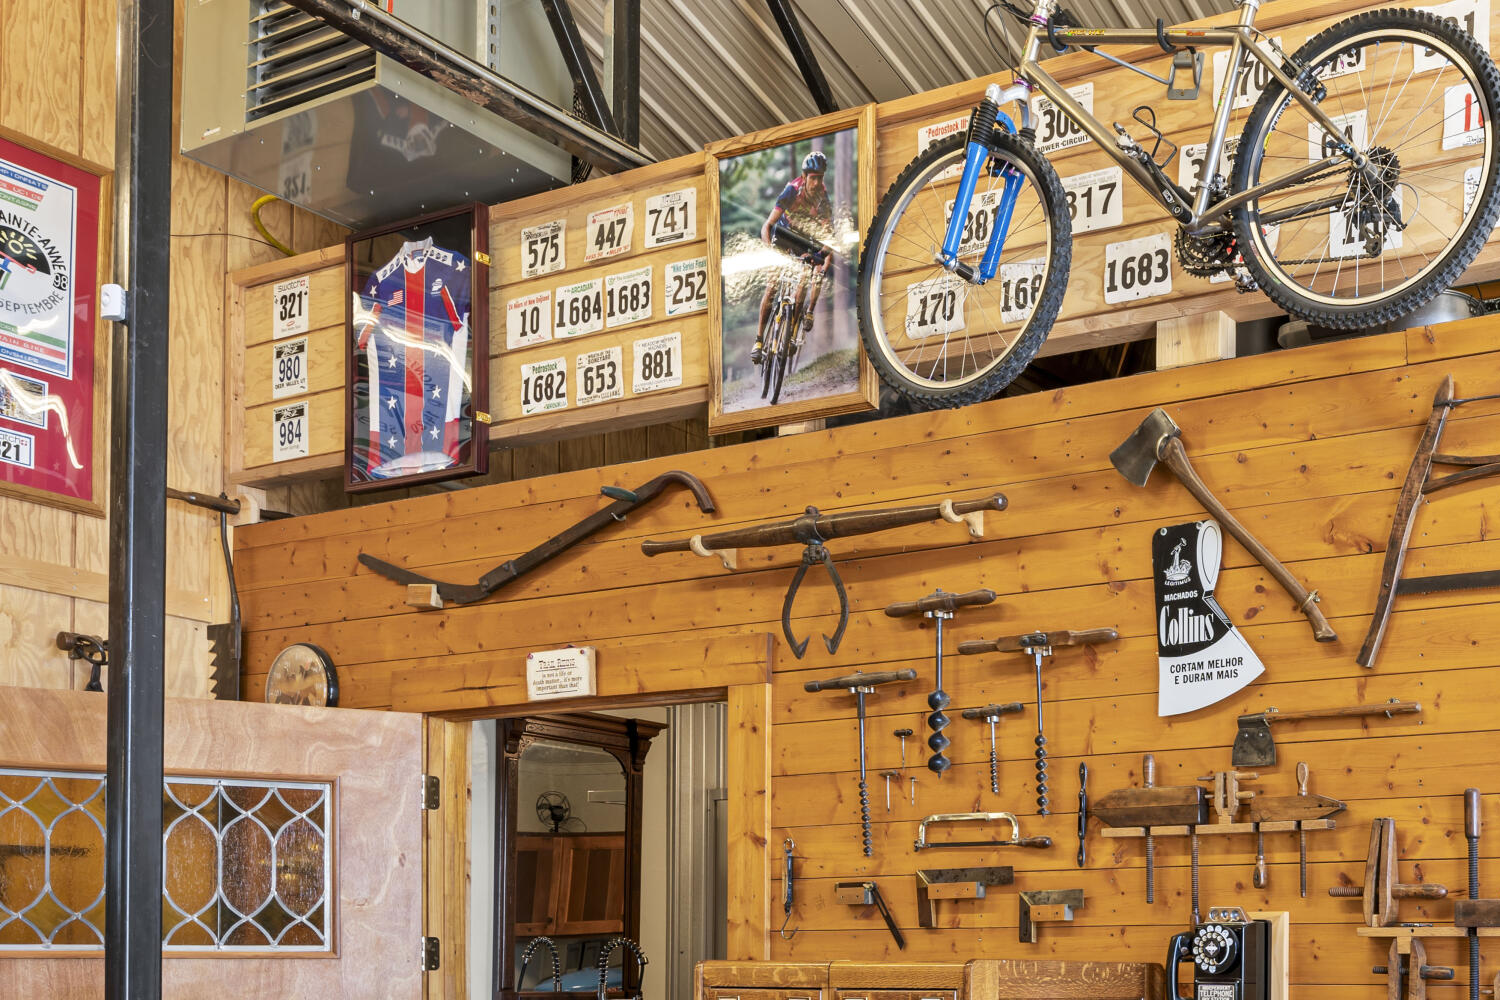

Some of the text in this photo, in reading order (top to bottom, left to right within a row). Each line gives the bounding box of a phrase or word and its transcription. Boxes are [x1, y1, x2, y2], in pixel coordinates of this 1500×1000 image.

[595, 218, 627, 251] 447
[649, 201, 688, 236] 741
[529, 234, 559, 269] 575
[672, 270, 707, 305] 252
[1106, 248, 1169, 294] 1683
[280, 291, 303, 321] 321
[556, 291, 602, 328] 1684
[607, 280, 650, 317] 1683
[918, 290, 956, 327] 170
[520, 306, 540, 337] 10
[279, 356, 300, 382] 980
[584, 361, 617, 395] 653
[642, 347, 673, 381] 881
[523, 370, 566, 405] 1682
[280, 419, 302, 446] 984
[1164, 590, 1198, 602] MACHADOS
[1160, 605, 1215, 647] Collins
[1170, 656, 1243, 674] CORTAM MELHOR
[1174, 668, 1239, 685] E DURAM MAIS
